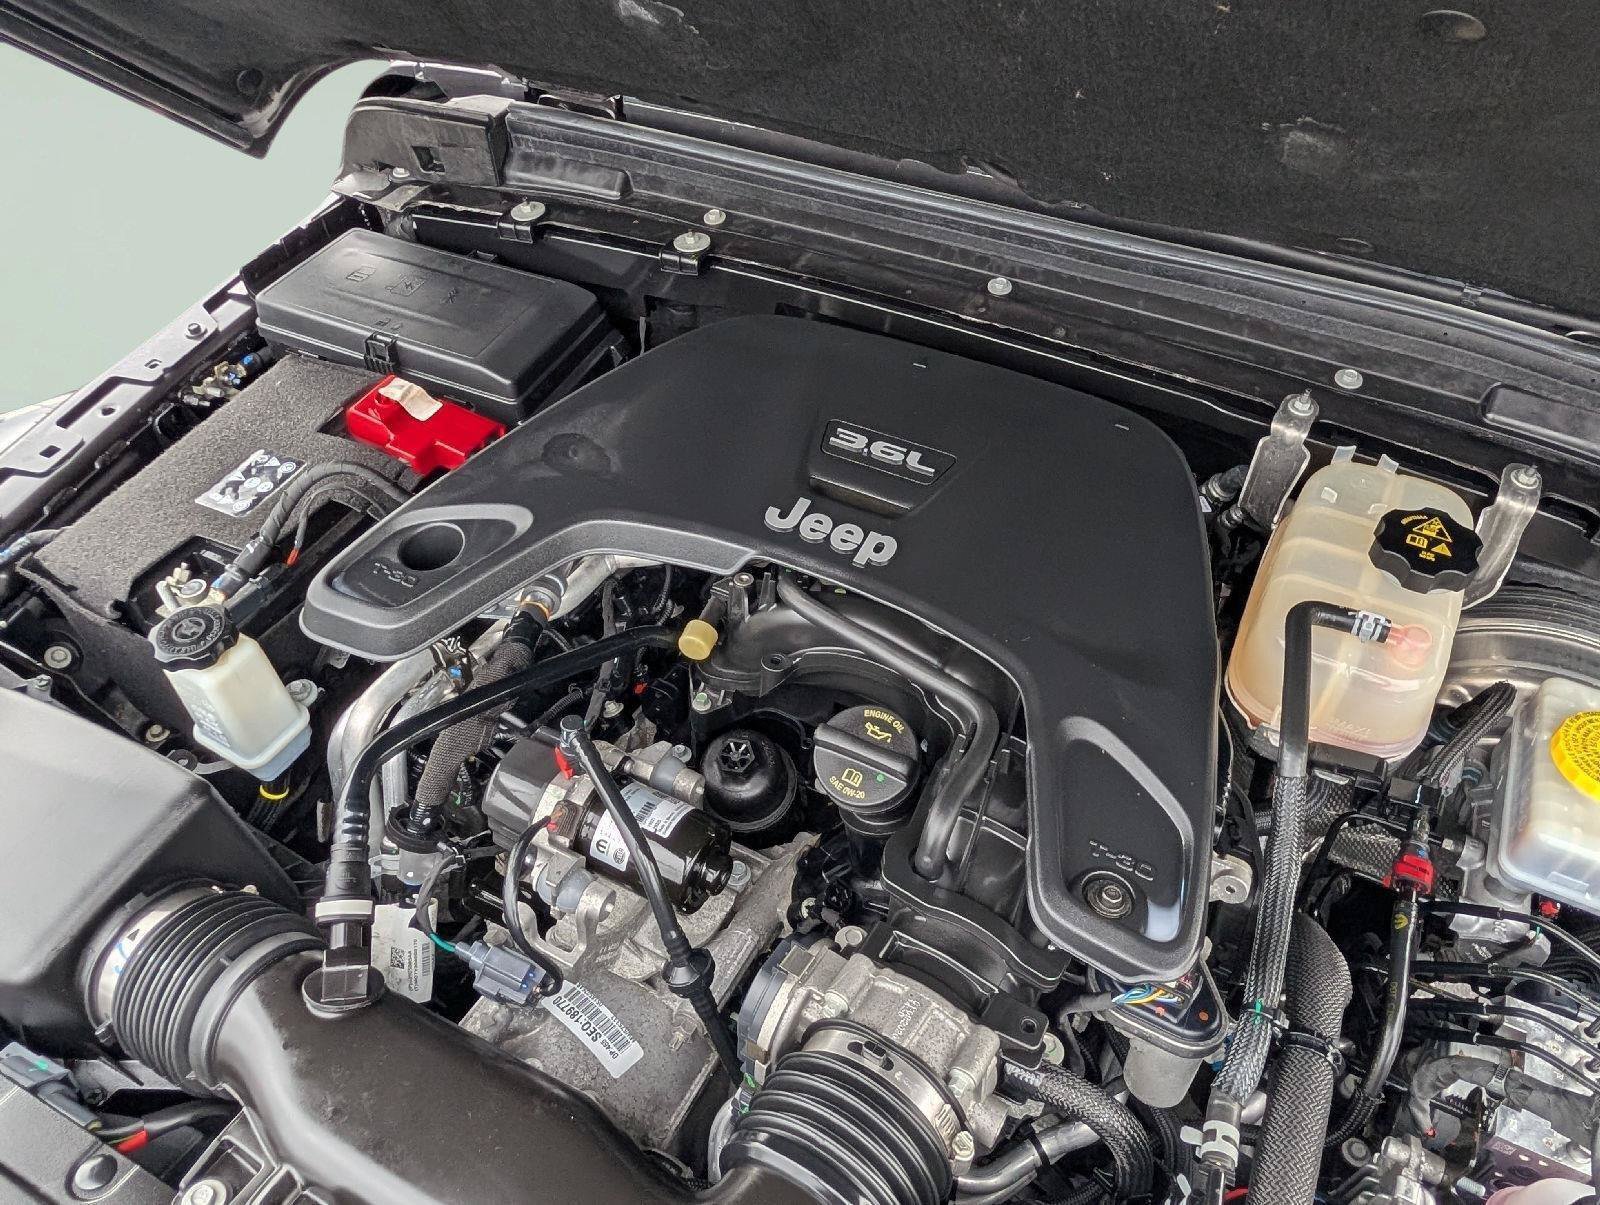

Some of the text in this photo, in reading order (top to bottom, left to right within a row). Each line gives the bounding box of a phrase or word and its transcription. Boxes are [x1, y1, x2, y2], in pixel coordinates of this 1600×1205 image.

[829, 427, 936, 477] 3.6L
[763, 496, 899, 569] Jeep
[864, 709, 905, 735] ENGINE OIL
[830, 775, 865, 799] SAE 0W-20
